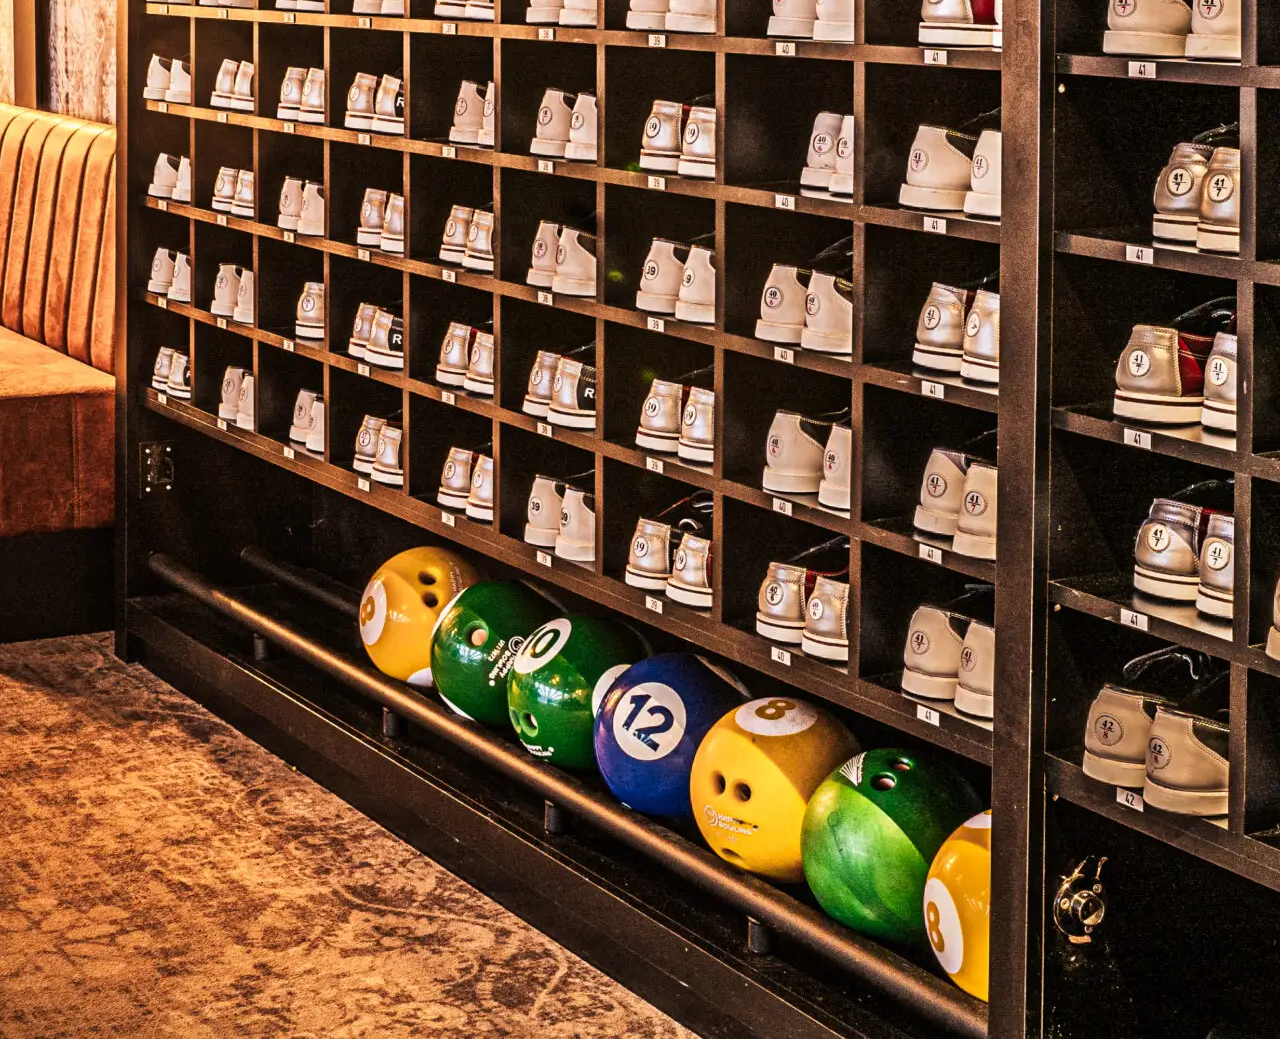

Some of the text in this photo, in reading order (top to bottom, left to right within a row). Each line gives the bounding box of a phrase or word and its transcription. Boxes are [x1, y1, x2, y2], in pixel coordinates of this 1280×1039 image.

[933, 52, 940, 63] 41
[1138, 64, 1146, 75] 41
[1173, 173, 1184, 182] 41
[1214, 178, 1225, 187] 41
[931, 220, 938, 231] 41
[1136, 248, 1144, 260] 41
[392, 334, 401, 344] R
[584, 388, 595, 398] R
[929, 384, 937, 395] 41
[1133, 434, 1141, 446] 41
[531, 502, 540, 510] 39
[1153, 529, 1163, 537] 41
[927, 548, 934, 559] 41
[360, 596, 375, 627] 8
[1130, 614, 1138, 626] 41
[755, 699, 796, 721] 8
[925, 710, 932, 721] 41
[622, 694, 674, 752] 12
[1102, 720, 1113, 730] 42
[1151, 744, 1162, 754] 42
[1125, 794, 1135, 806] 42
[718, 822, 753, 836] BOWLING
[926, 901, 945, 953] 8
